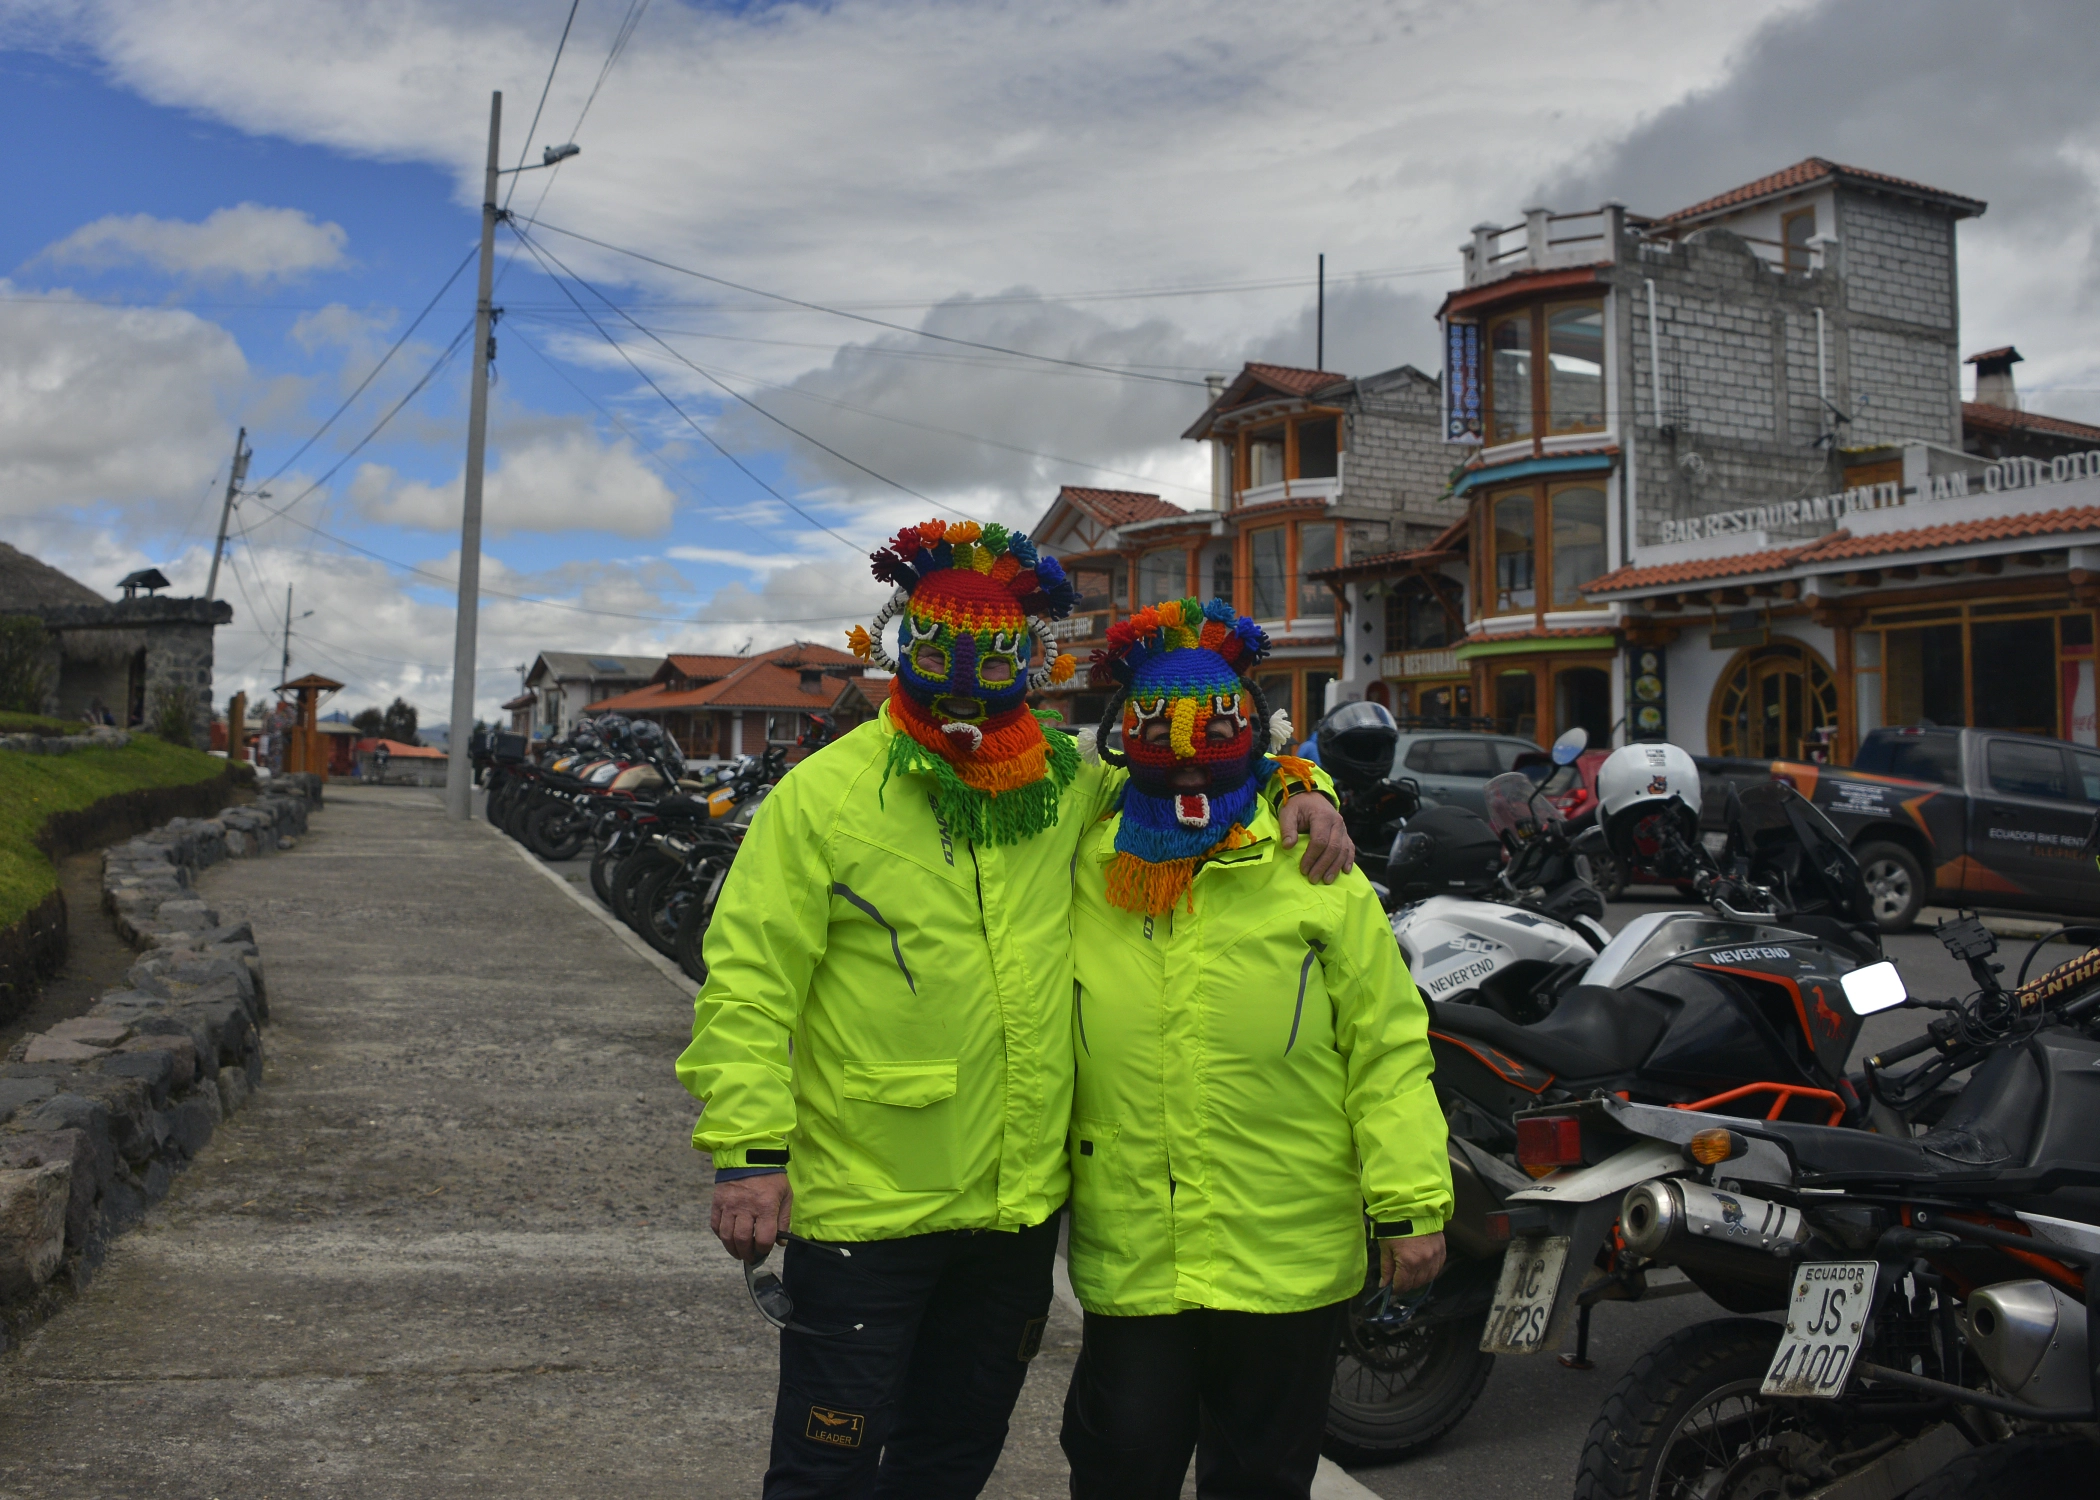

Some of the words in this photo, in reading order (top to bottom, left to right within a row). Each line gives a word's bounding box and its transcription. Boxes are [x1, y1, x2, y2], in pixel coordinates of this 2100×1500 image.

[1662, 518, 1701, 543] BAR
[1989, 828, 2036, 842] ECUADOR
[1448, 938, 1500, 953] 900
[1805, 1267, 1865, 1280] ECUADOR
[1807, 1287, 1847, 1336] JS
[1769, 1344, 1850, 1388] 410D
[851, 1418, 858, 1430] 1
[815, 1430, 852, 1444] LEADER
